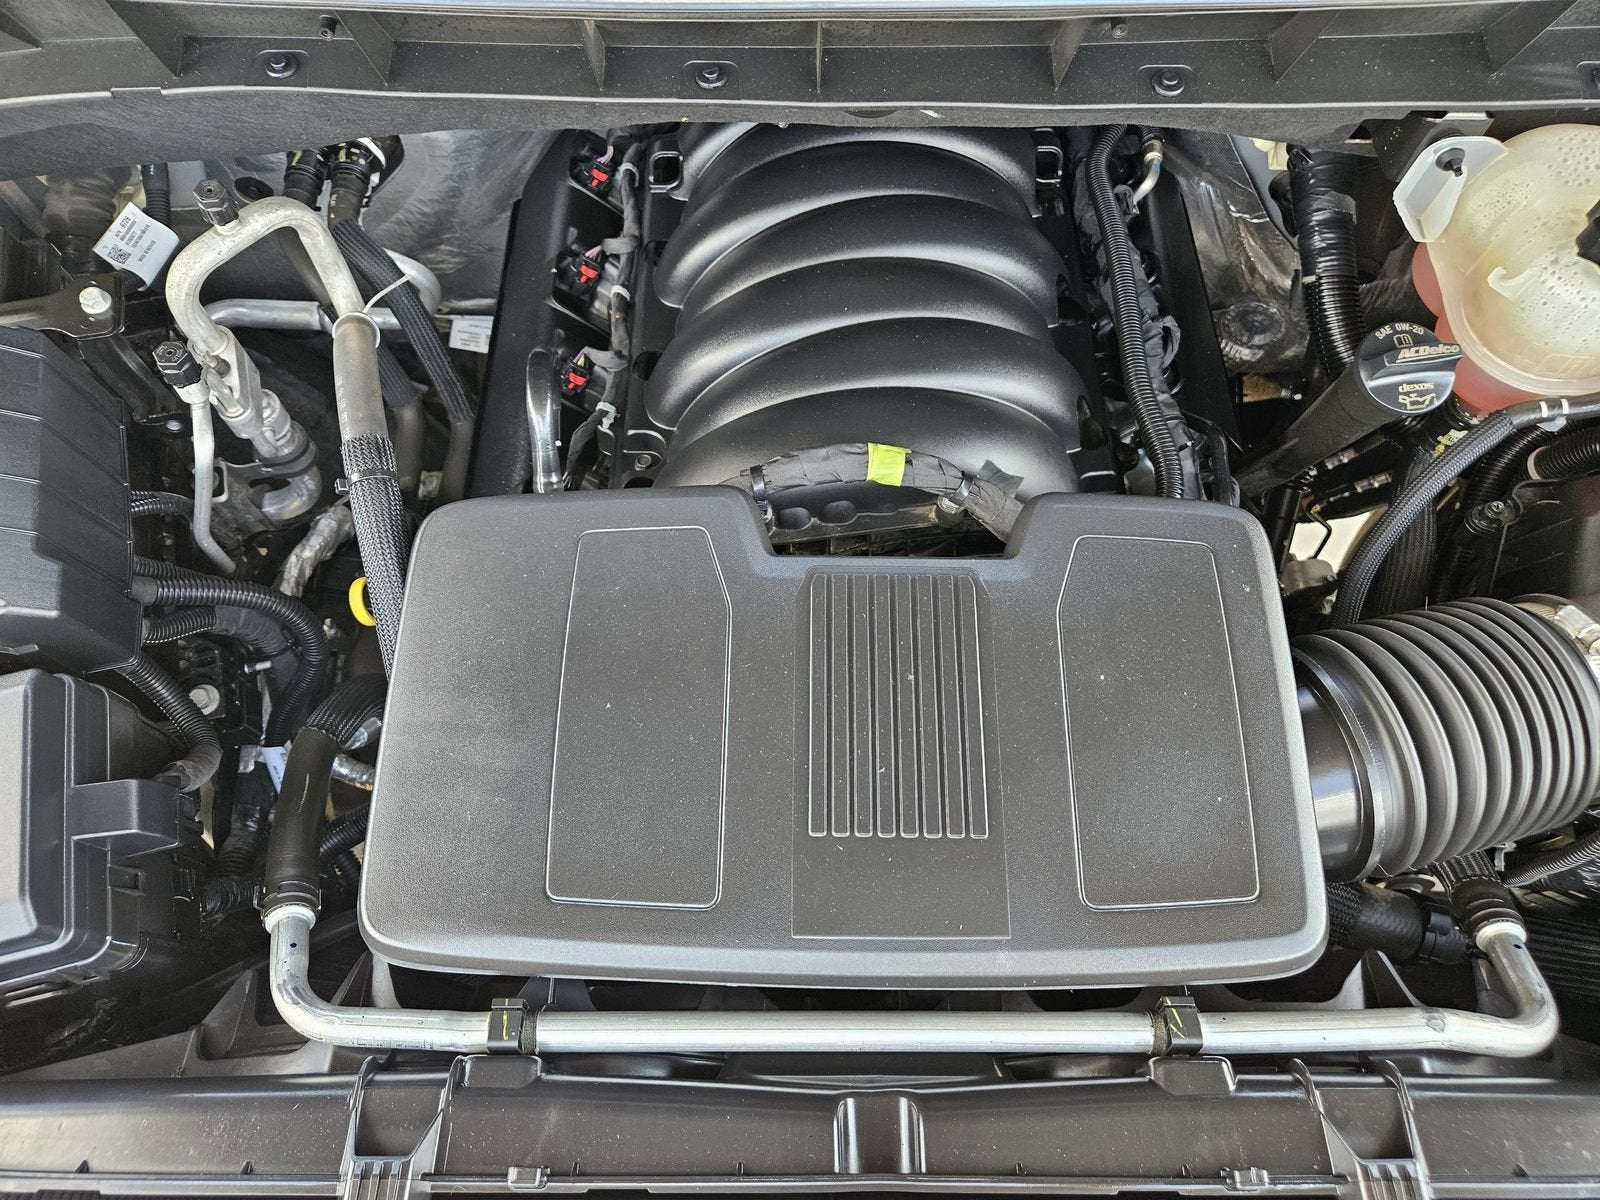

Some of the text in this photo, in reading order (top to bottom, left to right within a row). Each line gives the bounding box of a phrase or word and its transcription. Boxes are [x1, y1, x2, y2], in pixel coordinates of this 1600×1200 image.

[1375, 323, 1424, 339] SAE 0W-20
[1398, 344, 1460, 359] ACDelco
[1399, 383, 1434, 392] dexos
